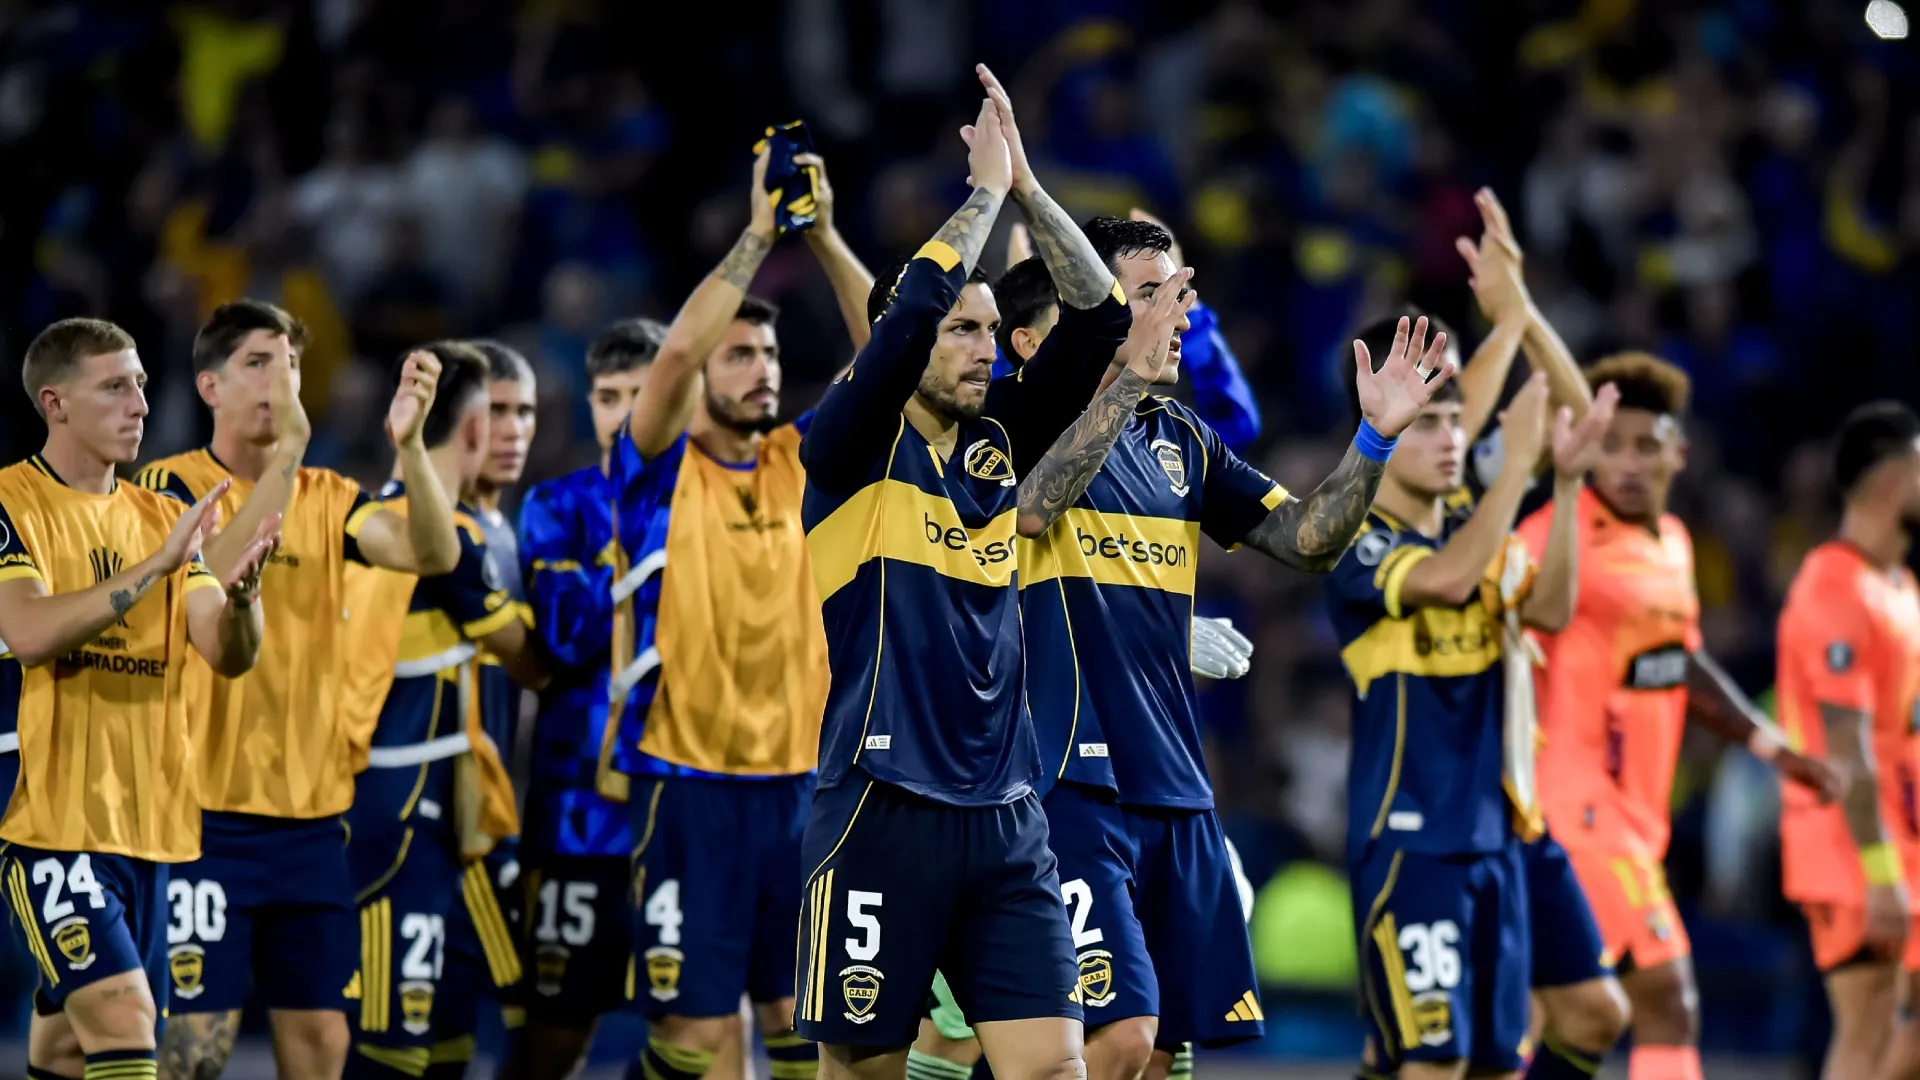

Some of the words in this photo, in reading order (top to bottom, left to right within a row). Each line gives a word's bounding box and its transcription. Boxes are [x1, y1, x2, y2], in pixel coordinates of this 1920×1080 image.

[981, 454, 1000, 475] CABJ
[1076, 527, 1186, 568] betsson
[32, 852, 106, 924] 24
[167, 878, 227, 944] 30
[536, 879, 598, 946] 15
[645, 878, 683, 945] 4
[400, 912, 445, 980] 21
[845, 889, 883, 962] 5
[1398, 919, 1462, 992] 36
[848, 988, 873, 998] CABJ
[1083, 971, 1106, 984] CABJ
